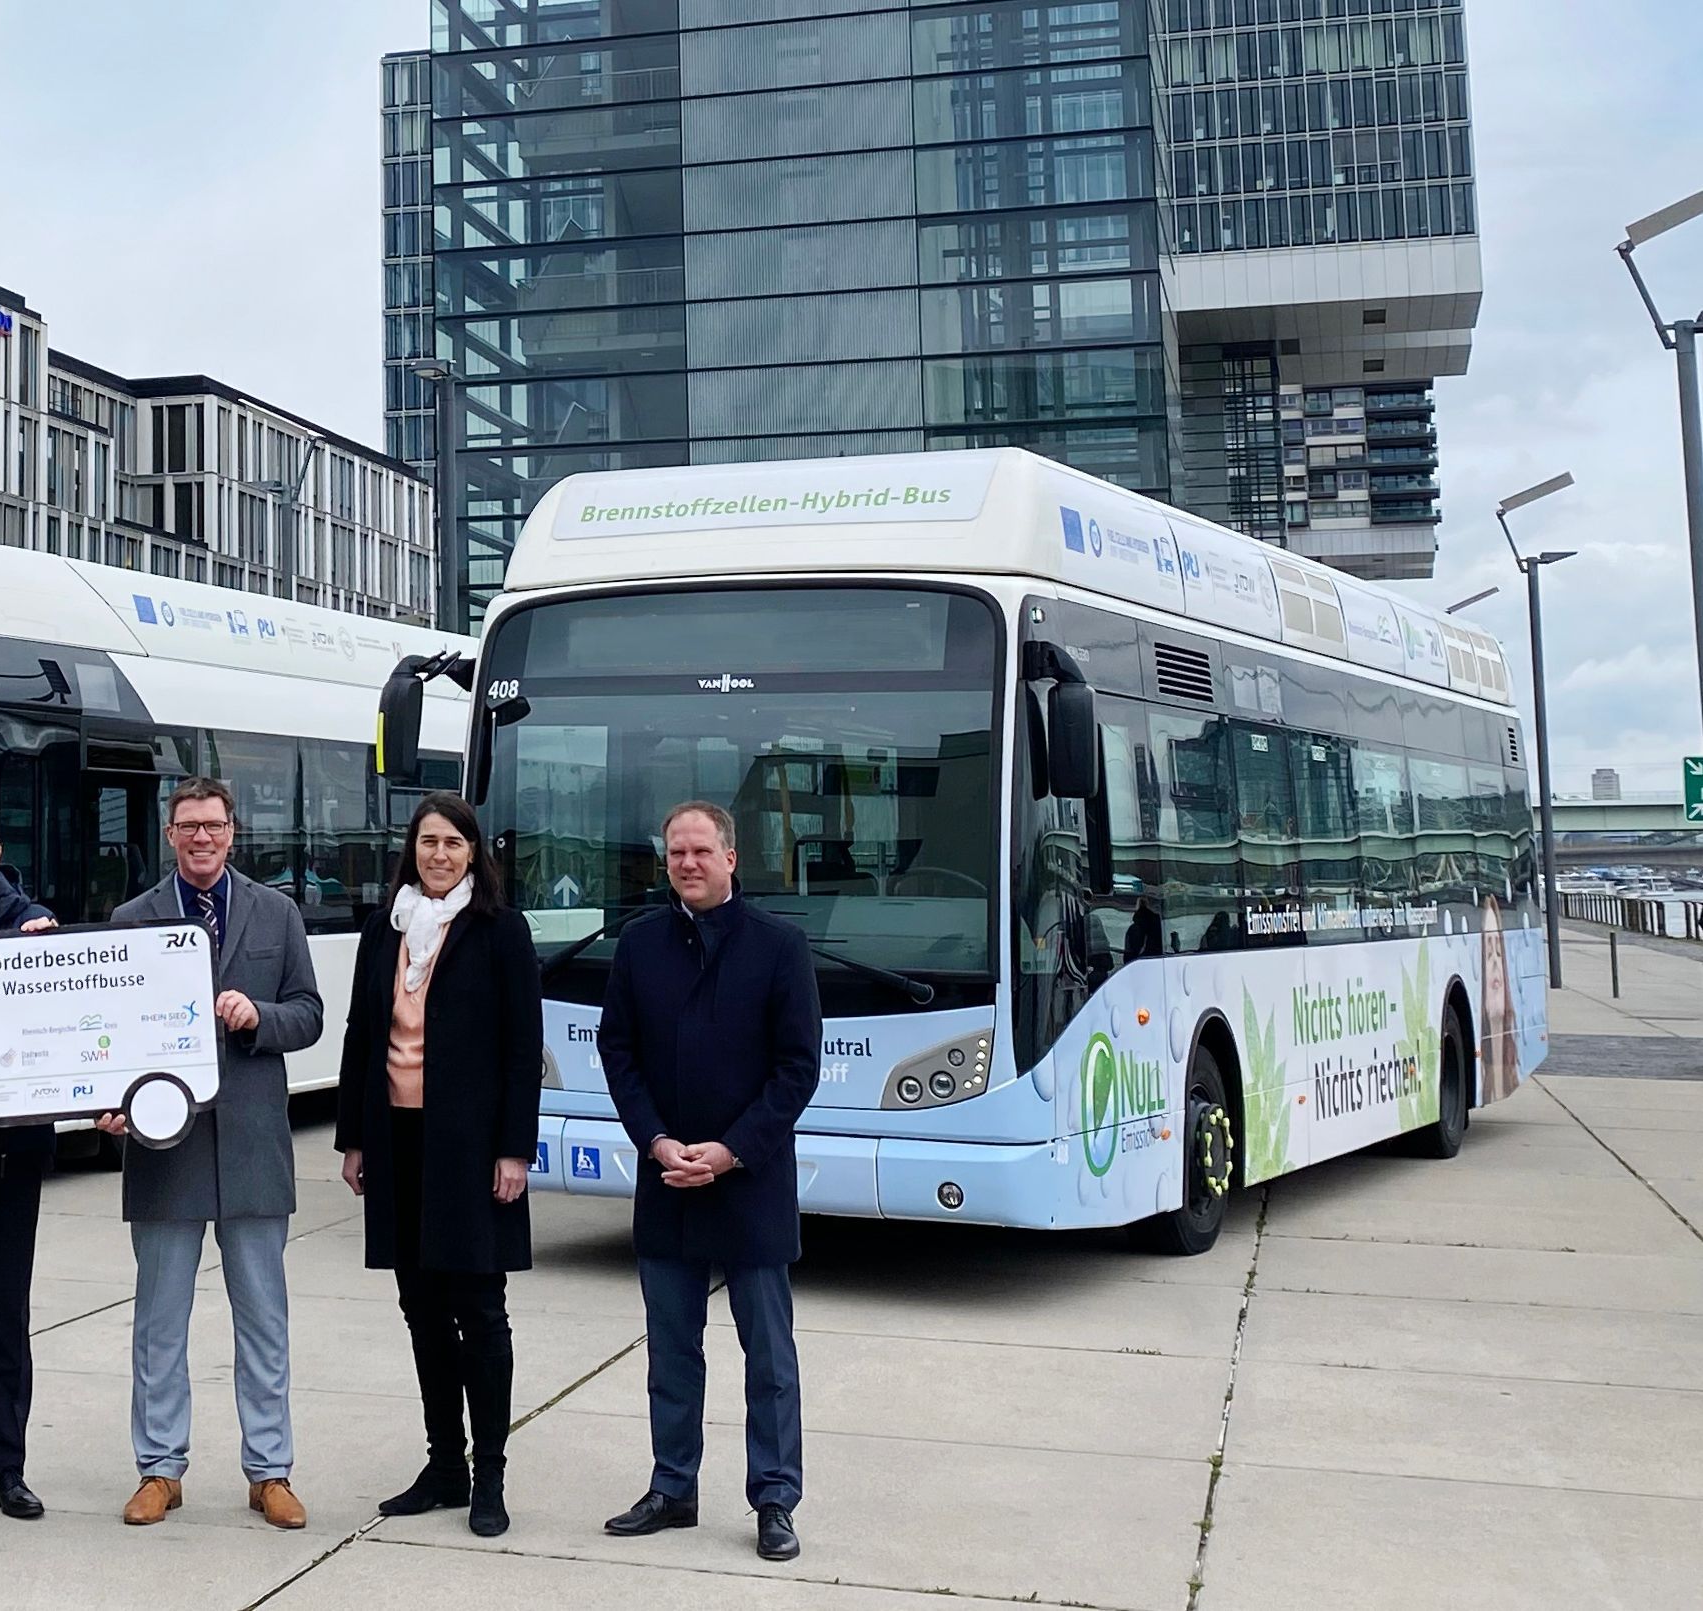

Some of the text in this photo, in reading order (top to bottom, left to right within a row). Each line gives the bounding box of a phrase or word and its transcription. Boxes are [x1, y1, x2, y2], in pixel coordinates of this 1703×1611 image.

[580, 485, 951, 523] Brennstoffzellen-Hybrid-Bus
[488, 679, 519, 700] 408
[2, 973, 145, 996] Wasserstoffbusse
[1293, 981, 1343, 1047] Nichts
[1347, 977, 1388, 1036] hören
[80, 1050, 109, 1063] SWH
[1120, 1049, 1166, 1117] NULL
[1315, 1039, 1422, 1121] Nichts riechen!
[1121, 1122, 1156, 1153] Emission
